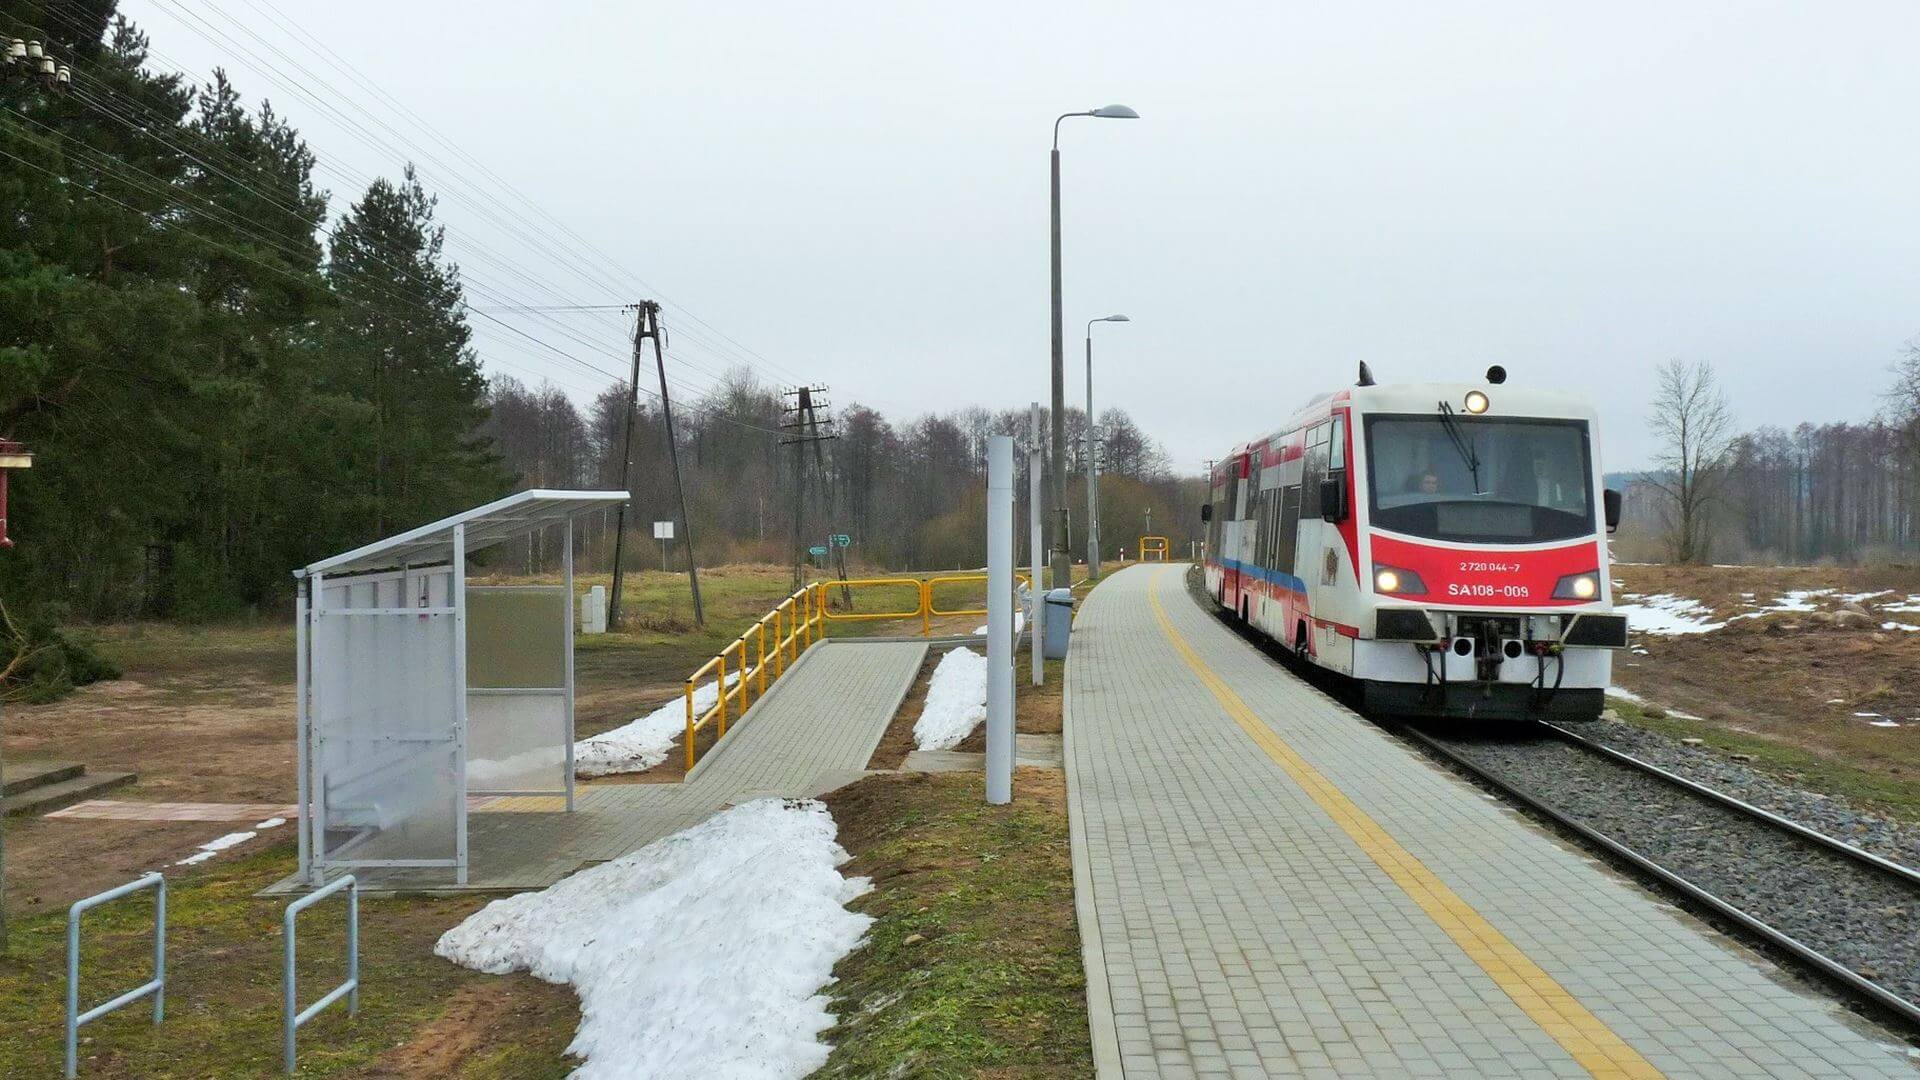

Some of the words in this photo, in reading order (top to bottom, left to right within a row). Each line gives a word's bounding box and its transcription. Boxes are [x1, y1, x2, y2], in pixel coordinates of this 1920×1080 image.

[1460, 562, 1467, 571] 2
[1468, 562, 1487, 571] 720
[1489, 562, 1520, 572] 044-7
[1448, 583, 1529, 598] SA108-009
